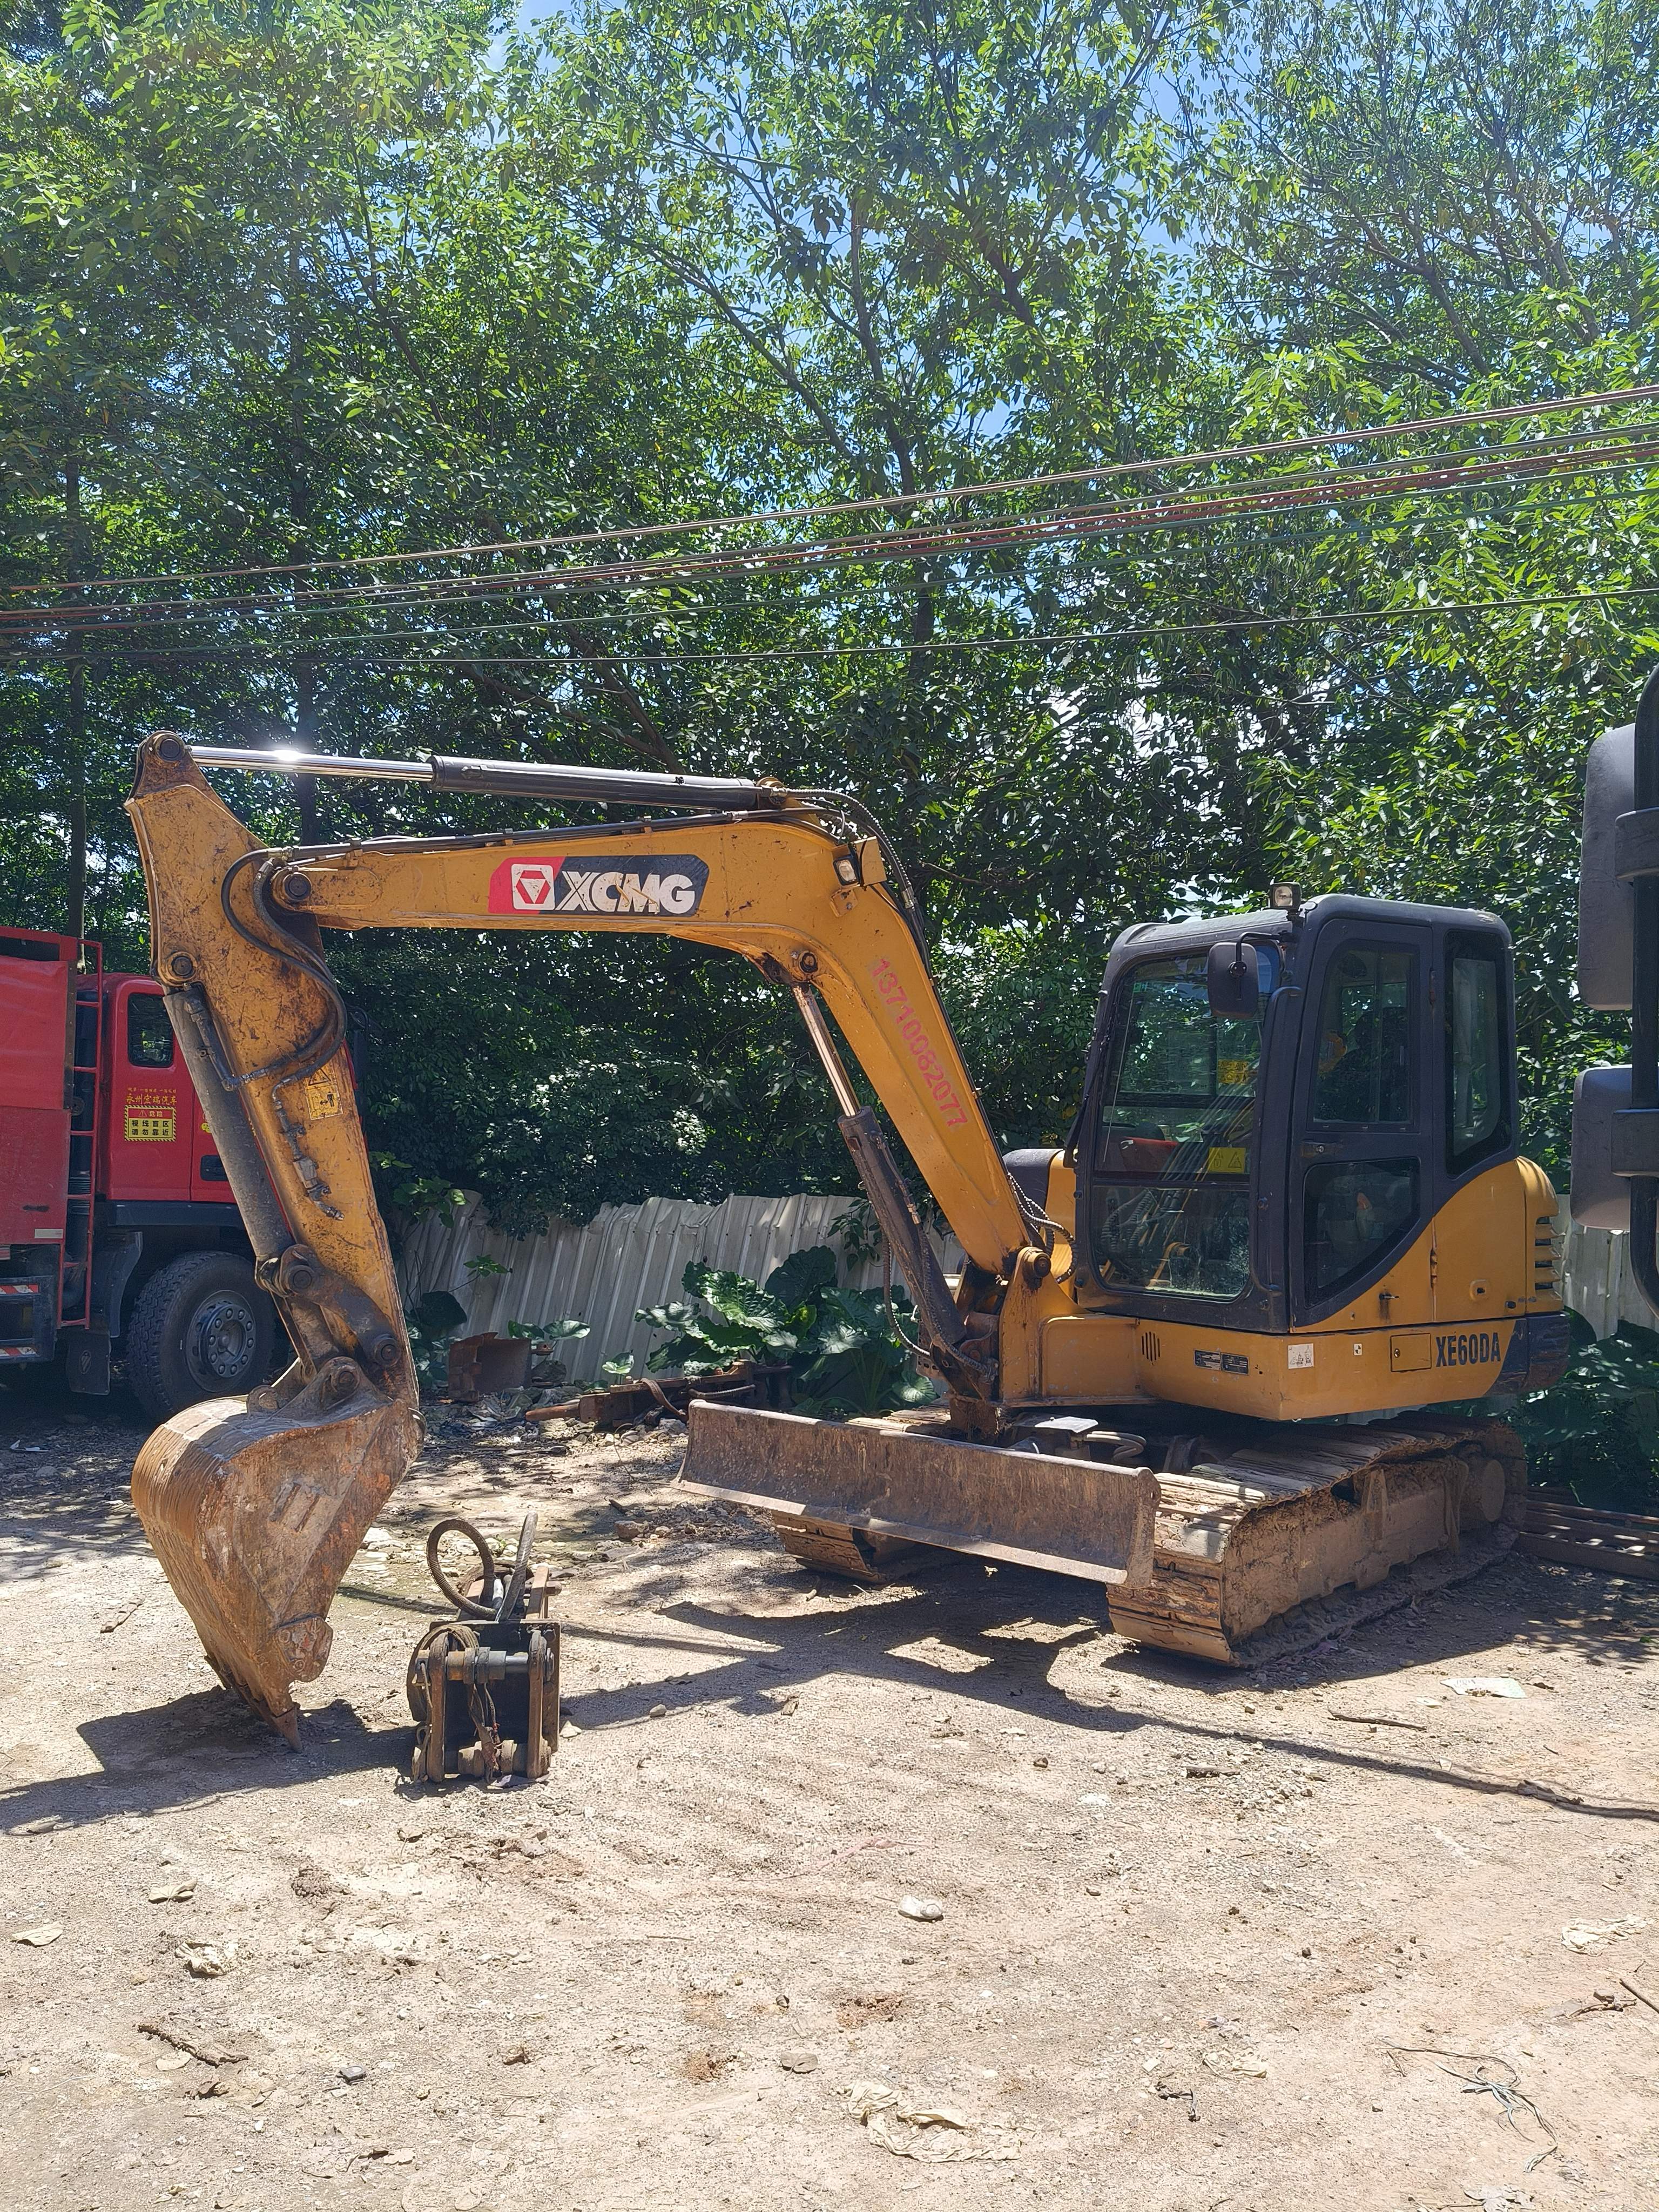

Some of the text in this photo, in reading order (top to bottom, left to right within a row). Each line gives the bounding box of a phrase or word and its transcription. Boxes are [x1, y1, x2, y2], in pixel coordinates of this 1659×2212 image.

[555, 871, 695, 914] XCMG
[872, 959, 968, 1127] 13710082077
[1436, 1332, 1501, 1367] XE60DA
